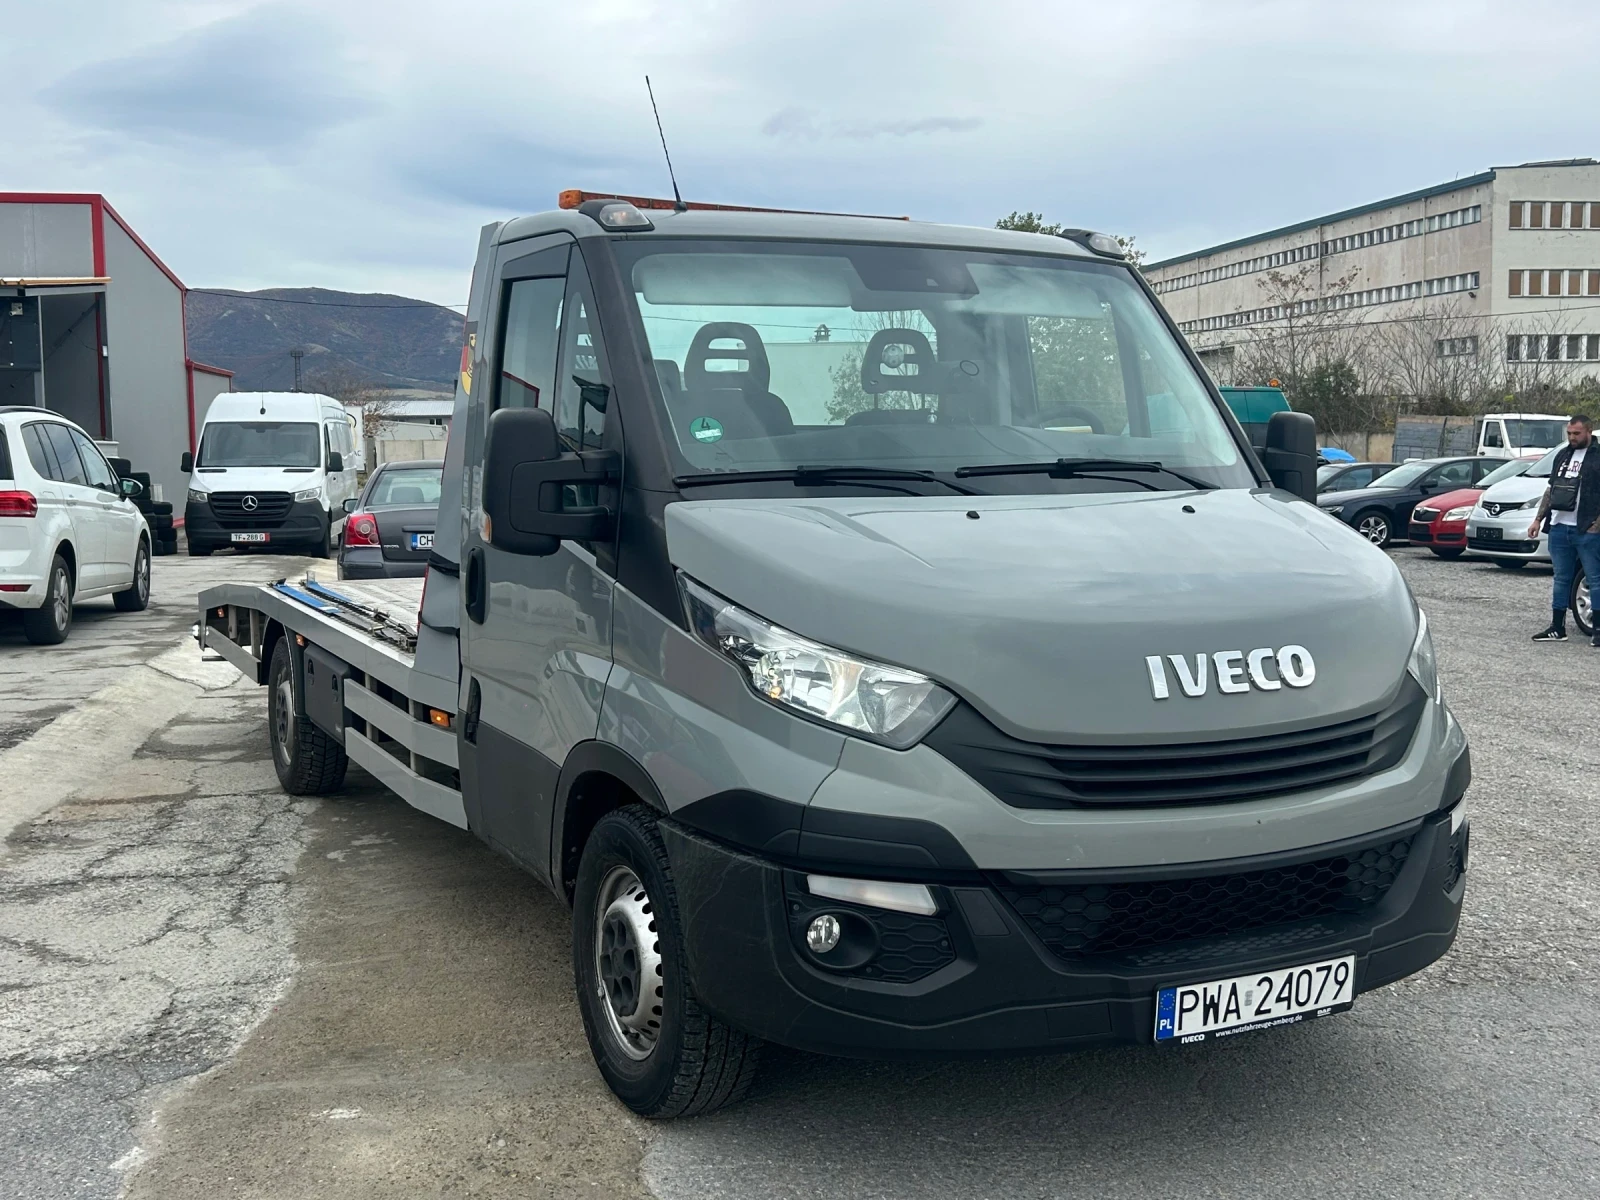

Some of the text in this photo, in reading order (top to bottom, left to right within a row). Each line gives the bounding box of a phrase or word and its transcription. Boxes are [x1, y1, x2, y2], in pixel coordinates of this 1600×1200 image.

[700, 417, 711, 430] 4
[420, 536, 434, 546] CH
[1145, 644, 1316, 700] IVECO
[1178, 961, 1350, 1031] PWA 24079
[1160, 1018, 1172, 1031] PL
[1216, 1014, 1303, 1038] www.nutzfahrzeuge-amberg.de
[1181, 1034, 1205, 1044] IVECO
